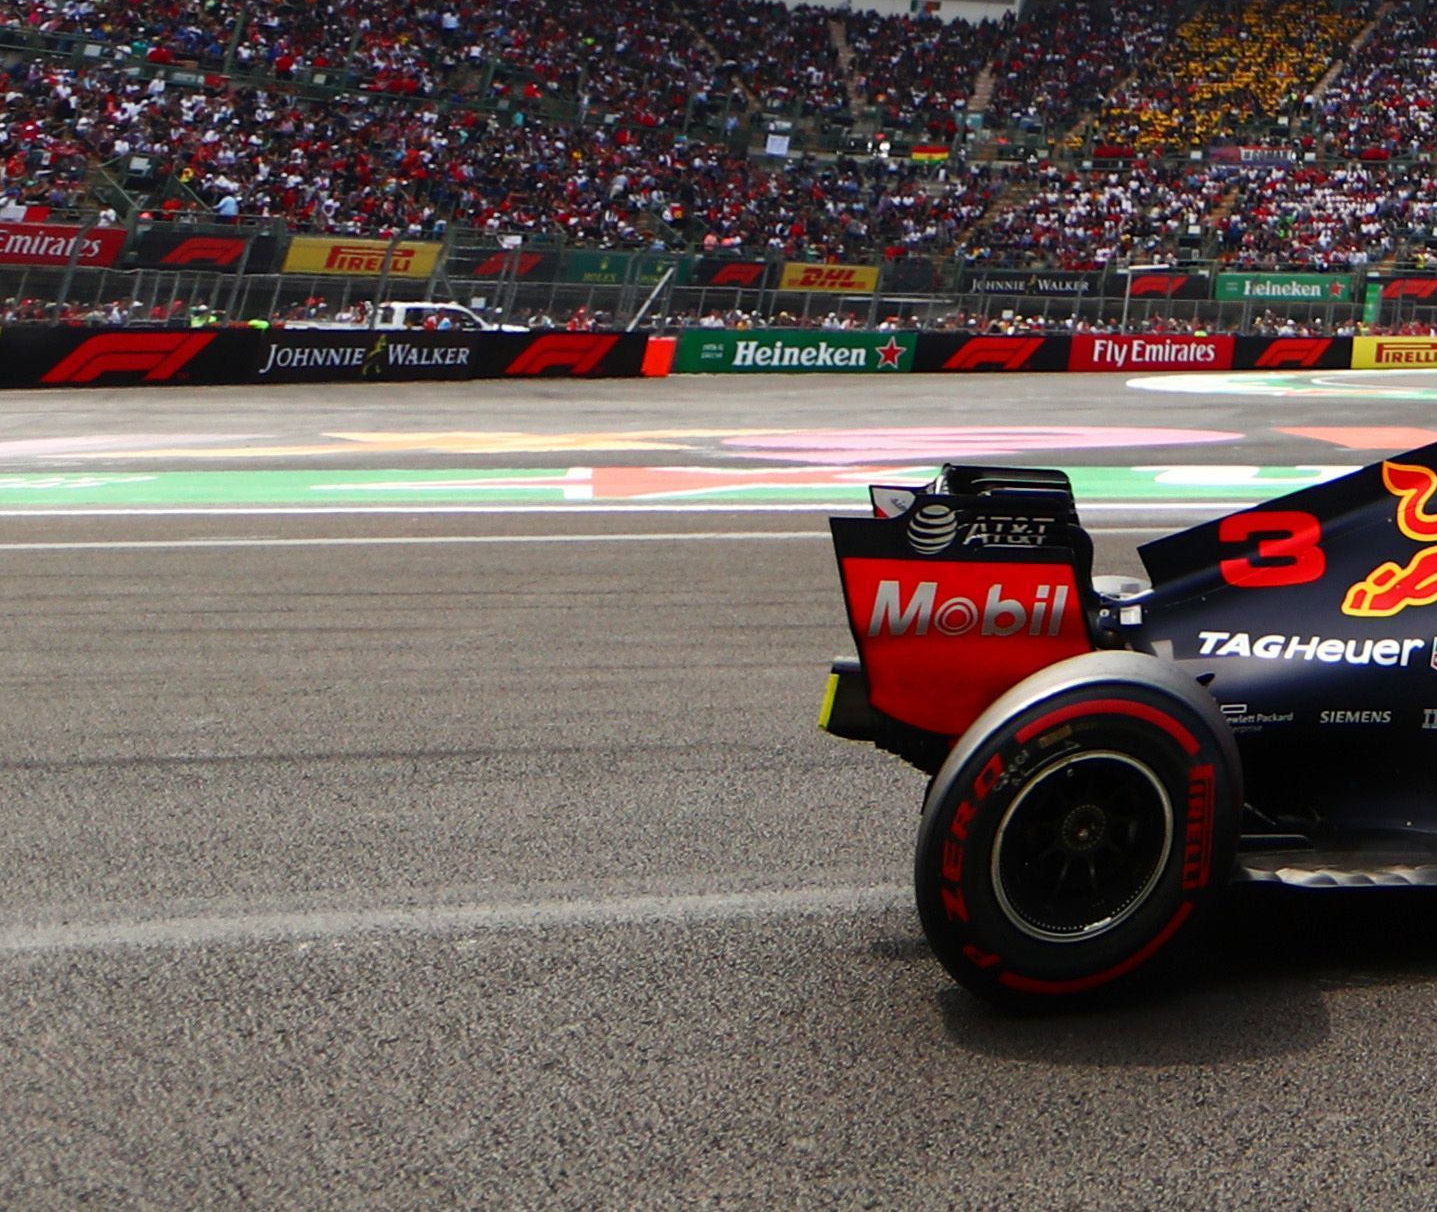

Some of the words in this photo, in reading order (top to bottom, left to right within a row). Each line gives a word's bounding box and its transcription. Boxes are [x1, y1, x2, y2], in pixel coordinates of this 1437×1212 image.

[325, 245, 415, 272] PIRELI
[1244, 279, 1321, 298] Heineken
[259, 344, 366, 374] JOHNNIE
[387, 343, 471, 365] WALKER
[731, 341, 867, 367] Heineken
[1093, 339, 1129, 368] Fly
[1131, 339, 1216, 364] Emirates
[1218, 511, 1326, 588] 3
[868, 580, 1069, 636] Mobil
[1225, 714, 1256, 724] ewlett
[1319, 710, 1392, 724] SIEMENS
